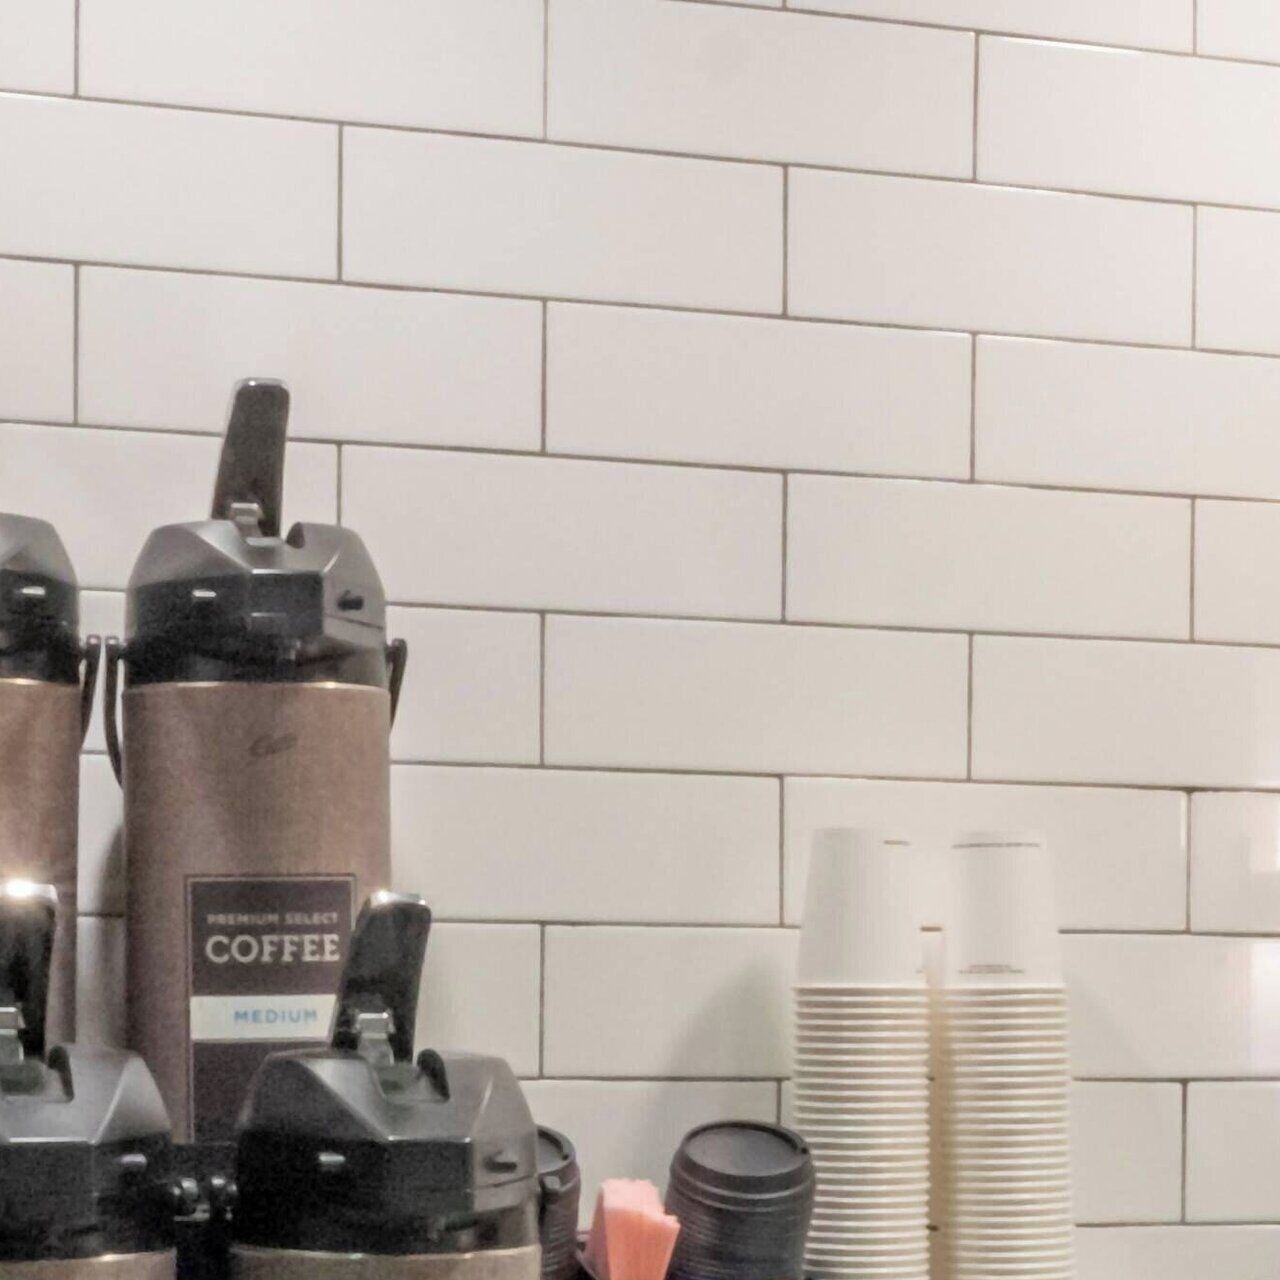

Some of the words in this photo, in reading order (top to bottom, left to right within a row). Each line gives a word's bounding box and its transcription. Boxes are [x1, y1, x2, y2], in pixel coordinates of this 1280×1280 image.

[207, 913, 279, 925] PREMIUM
[285, 911, 338, 925] SELECT
[205, 933, 341, 964] COFFEE
[234, 1009, 318, 1024] MEDIUM
